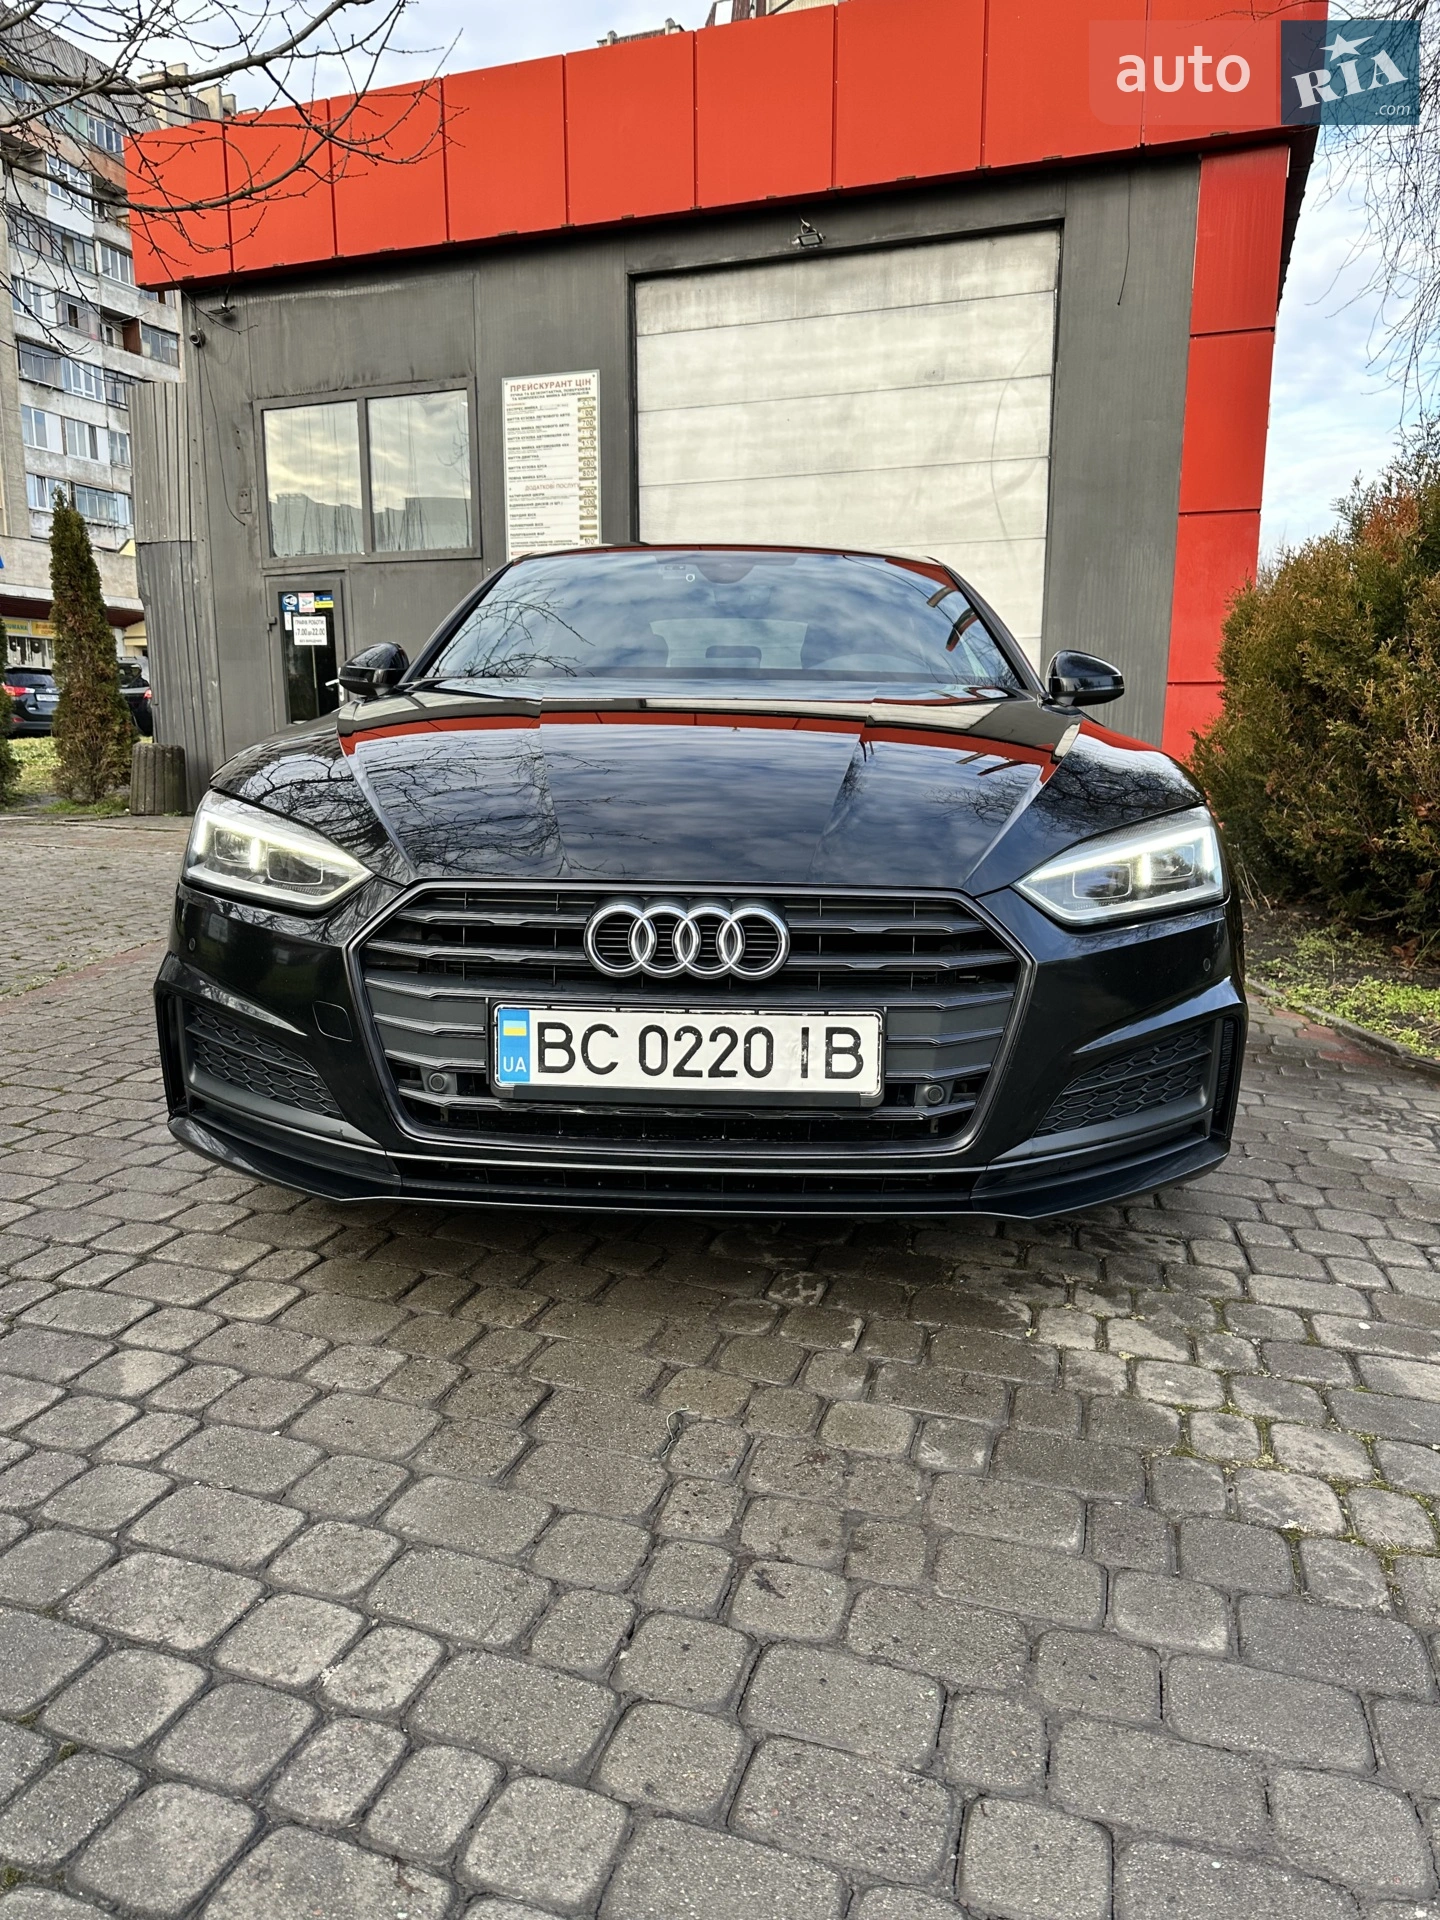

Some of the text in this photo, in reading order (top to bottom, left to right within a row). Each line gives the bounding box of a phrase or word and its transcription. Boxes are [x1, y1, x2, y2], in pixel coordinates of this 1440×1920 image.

[510, 378, 591, 392] ПРЕЙСКУРАНТ ЦІН
[537, 1022, 863, 1079] BC 0220 IB
[503, 1057, 527, 1073] UA
